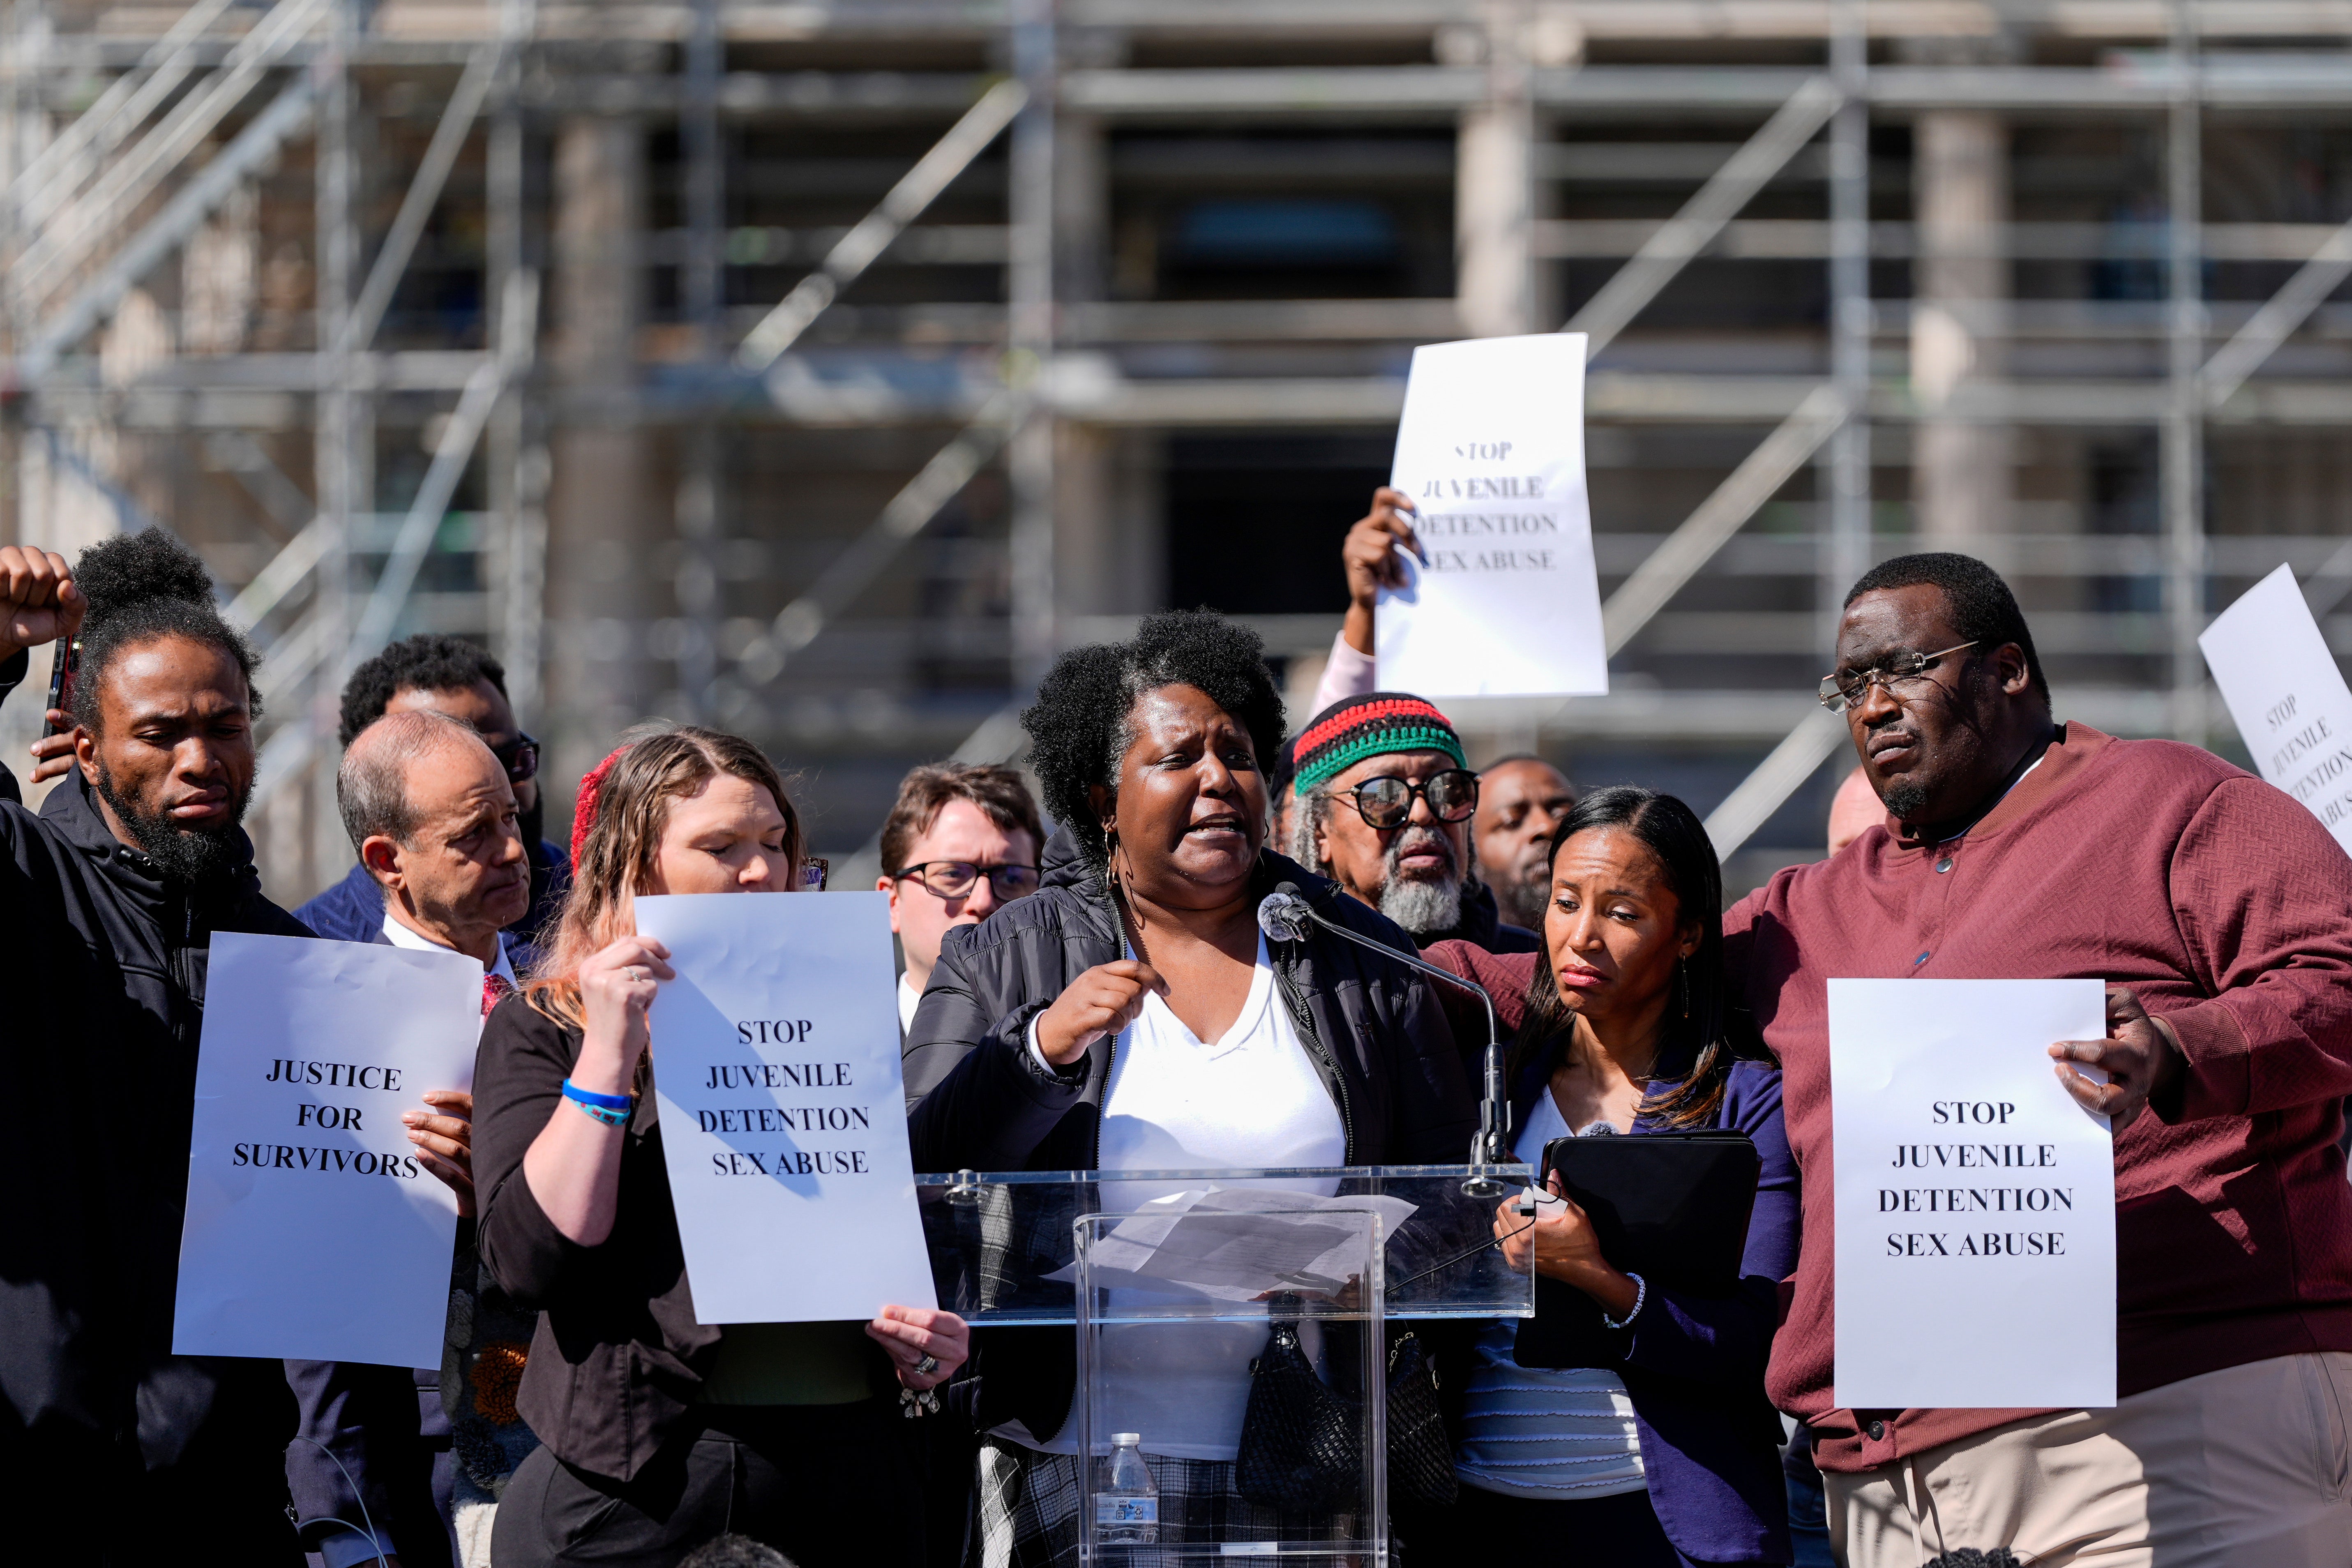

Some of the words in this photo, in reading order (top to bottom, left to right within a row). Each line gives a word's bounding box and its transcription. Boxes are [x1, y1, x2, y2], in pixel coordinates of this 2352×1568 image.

[1423, 476, 1544, 500] JUVENILE
[1425, 549, 1469, 573] EX
[1475, 549, 1558, 572] ABUSE
[2266, 693, 2297, 733] STOP
[2273, 716, 2332, 775] JUVENILE
[2289, 745, 2352, 804] TENTION
[738, 1020, 812, 1045] STOP
[266, 1058, 401, 1091] JUSTICE
[706, 1063, 852, 1089] JUVENILE
[295, 1104, 363, 1131] FOR
[696, 1107, 869, 1132] DETENTION
[1933, 1101, 2015, 1124] STOP
[233, 1142, 419, 1179] SURVIVORS
[713, 1153, 768, 1176] SEX
[775, 1151, 869, 1175] ABUSE
[1892, 1144, 2057, 1168] JUVENILE
[1877, 1188, 2073, 1212] DETENTION
[1887, 1233, 1950, 1257] SEX
[1957, 1232, 2066, 1256] ABUSE
